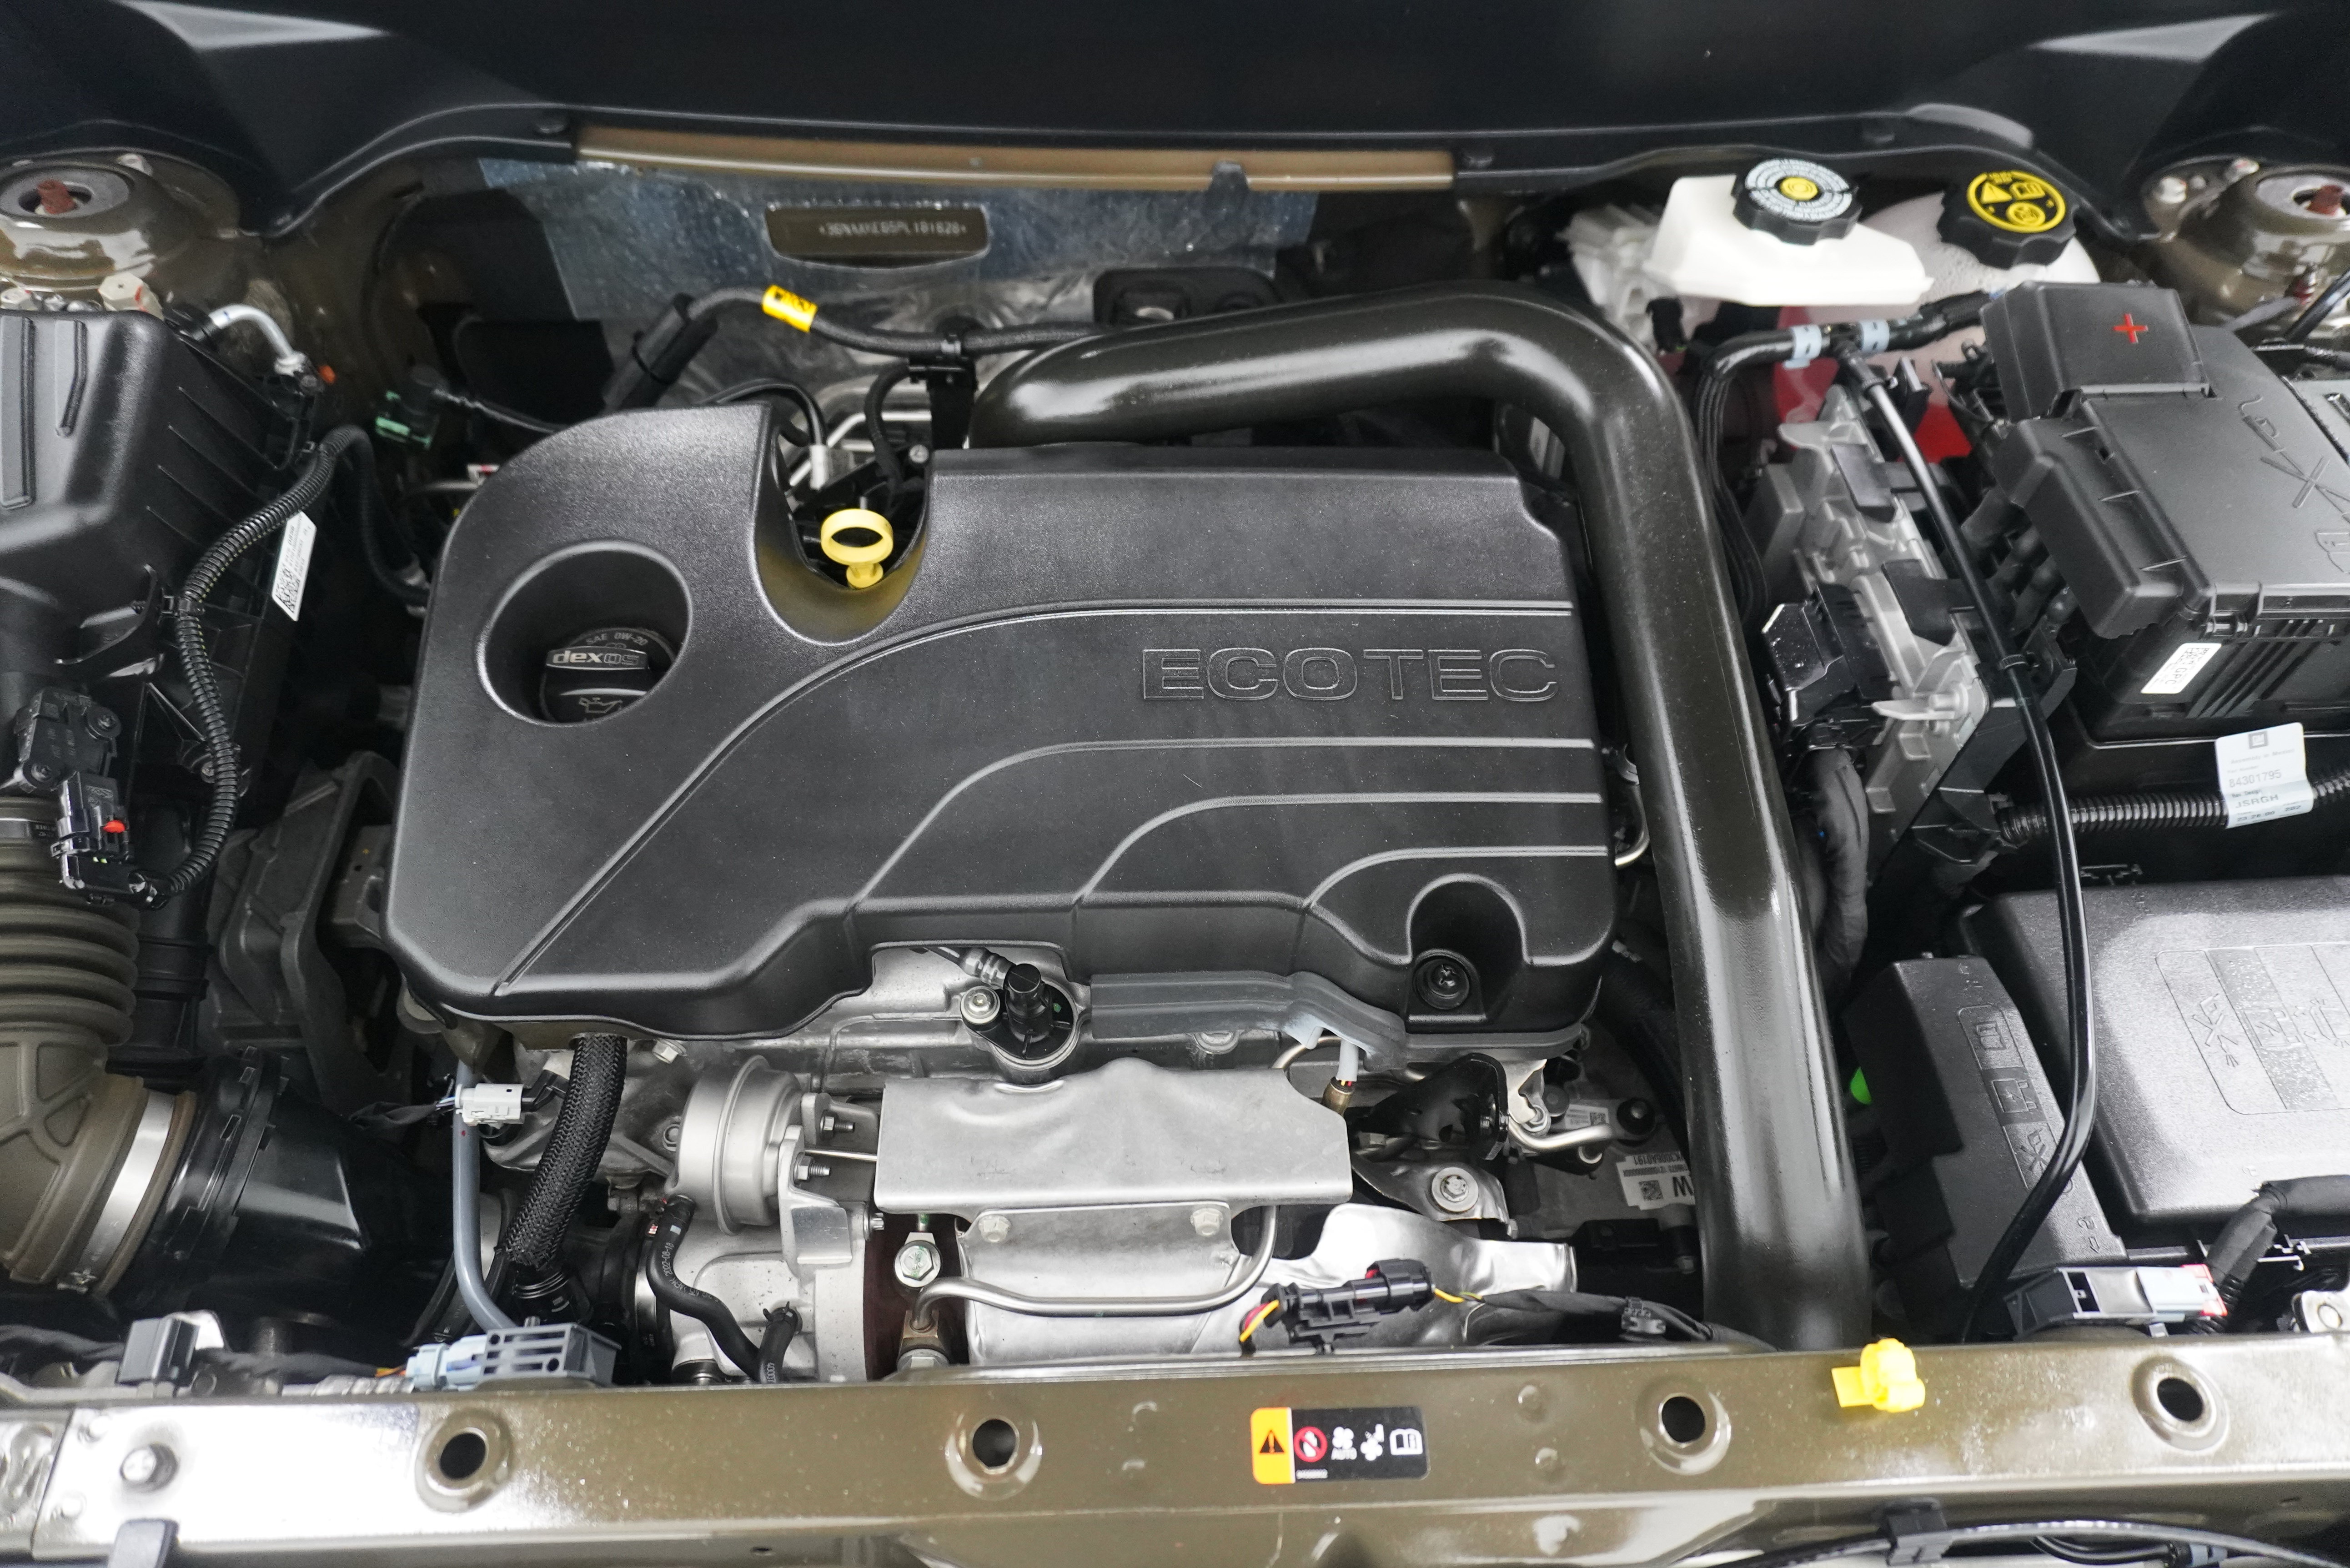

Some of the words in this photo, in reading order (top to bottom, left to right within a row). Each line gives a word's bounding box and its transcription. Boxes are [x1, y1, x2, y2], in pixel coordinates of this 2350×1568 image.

[586, 633, 607, 645] SAE
[614, 633, 648, 646] 0W-20
[552, 650, 639, 666] dexos
[1142, 647, 1559, 703] ECOTEC
[2165, 667, 2187, 684] GPC
[2231, 755, 2261, 764] Assembly
[2229, 769, 2282, 788] 84301795
[2235, 794, 2279, 809] JSRGH
[1331, 1447, 1357, 1460] AUTO
